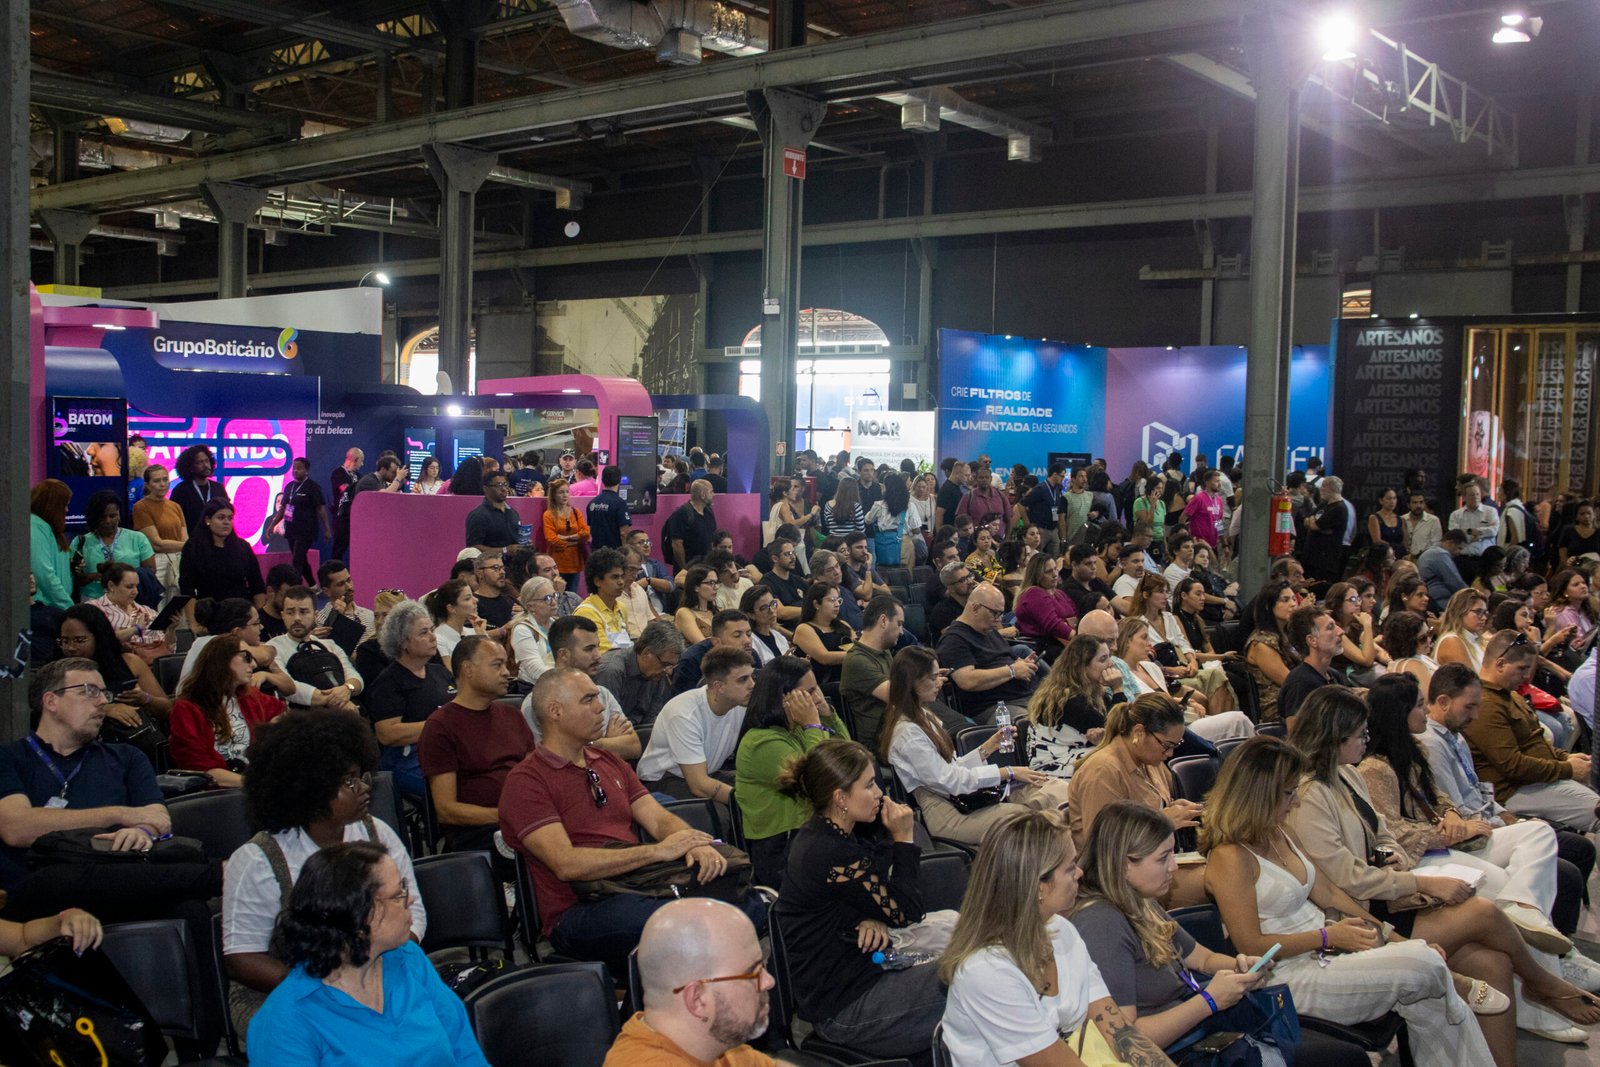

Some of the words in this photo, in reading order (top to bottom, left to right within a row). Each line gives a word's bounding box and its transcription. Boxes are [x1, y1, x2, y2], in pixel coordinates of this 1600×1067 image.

[1356, 329, 1444, 346] ARTESANOS
[153, 336, 275, 358] GrupoBoticário
[1369, 349, 1443, 362] ARTESANOS
[1355, 364, 1442, 379] ARTESANOS
[951, 386, 969, 397] CRIE
[970, 387, 1021, 401] FILTROS
[1022, 391, 1031, 402] DE
[1368, 383, 1442, 397] ARTESANOS
[986, 405, 1053, 418] REALIDADE
[1353, 398, 1440, 414] ARTESANOS
[68, 413, 113, 425] BATOM
[1367, 418, 1440, 431] ARTESANOS
[314, 425, 326, 434] da
[326, 425, 353, 434] beleza
[858, 420, 900, 436] NOAR
[951, 420, 1030, 432] AUMENTADA
[1032, 423, 1042, 433] EM
[1043, 423, 1078, 434] SEGUNDOS
